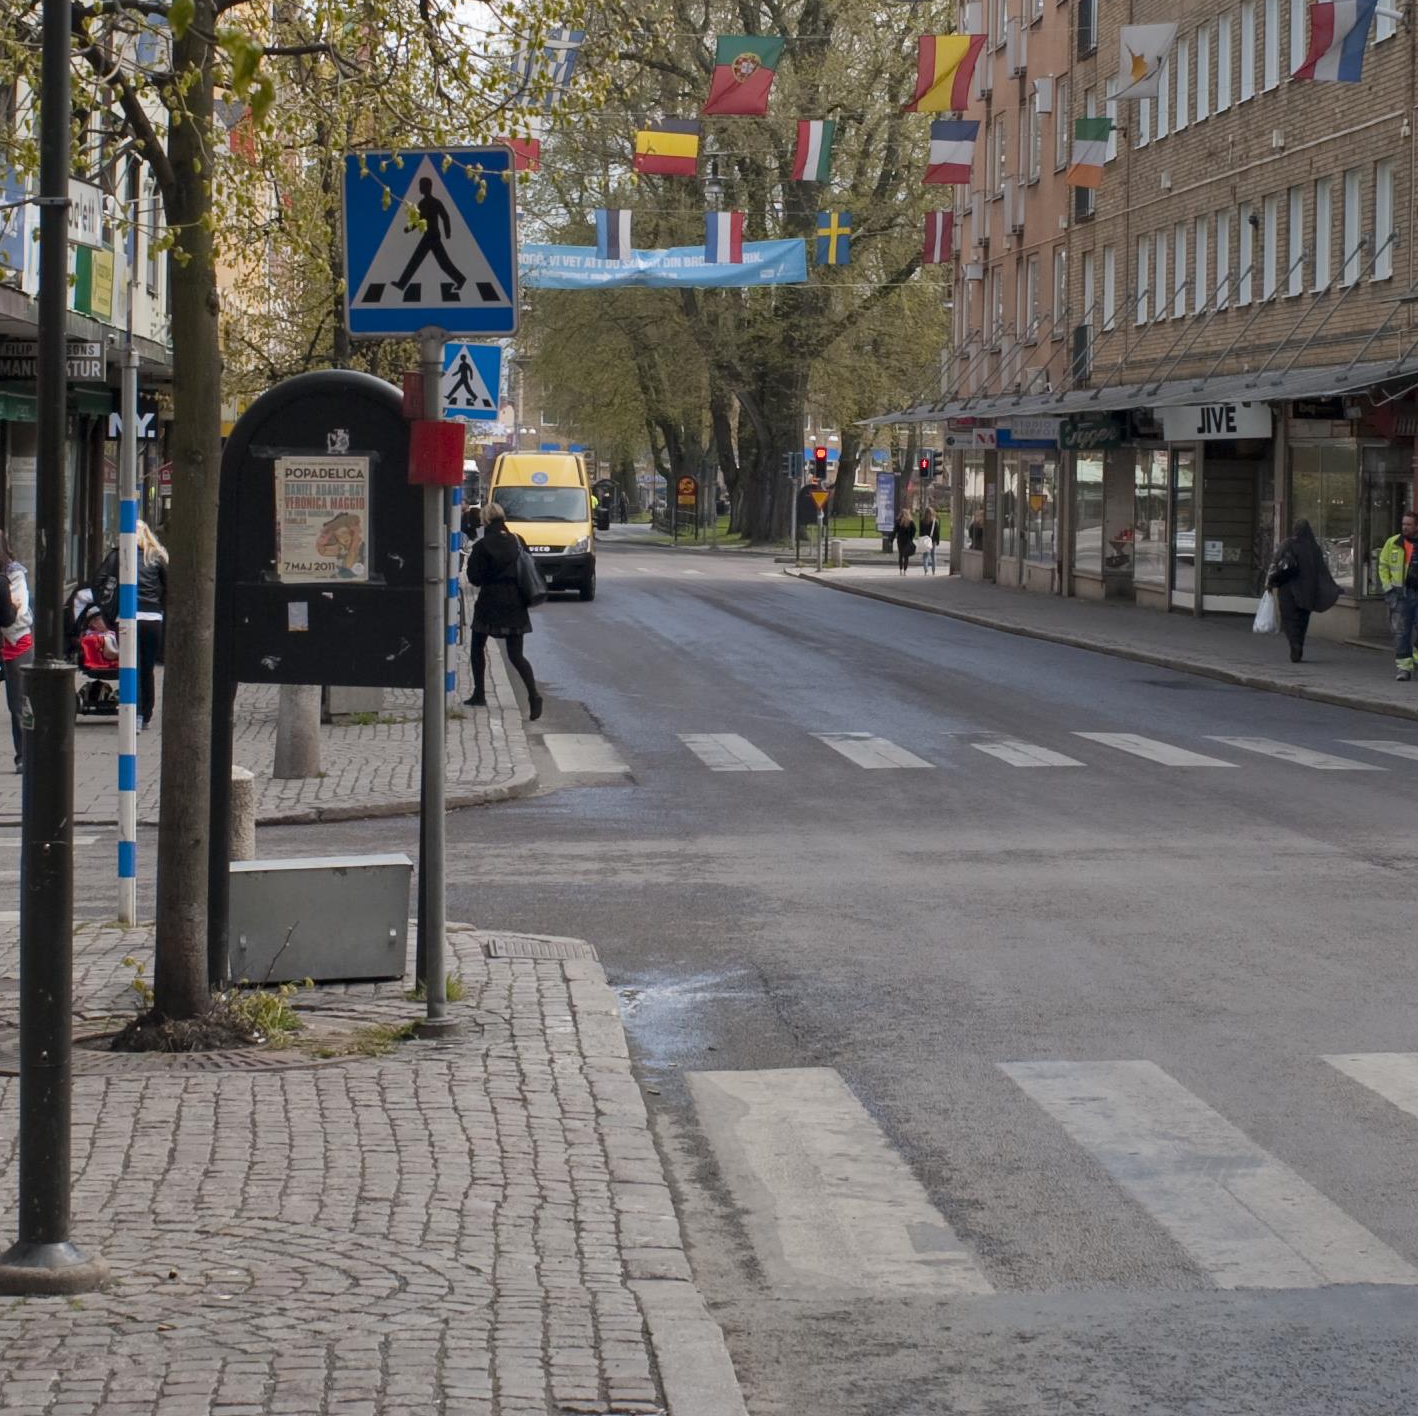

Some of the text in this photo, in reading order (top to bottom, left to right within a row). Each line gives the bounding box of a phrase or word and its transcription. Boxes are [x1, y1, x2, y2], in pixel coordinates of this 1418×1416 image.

[1197, 406, 1237, 433] JIVE
[285, 468, 365, 479] POPADELICA
[285, 497, 365, 510] VERONICA MAGGIO
[315, 562, 335, 571] 2011
